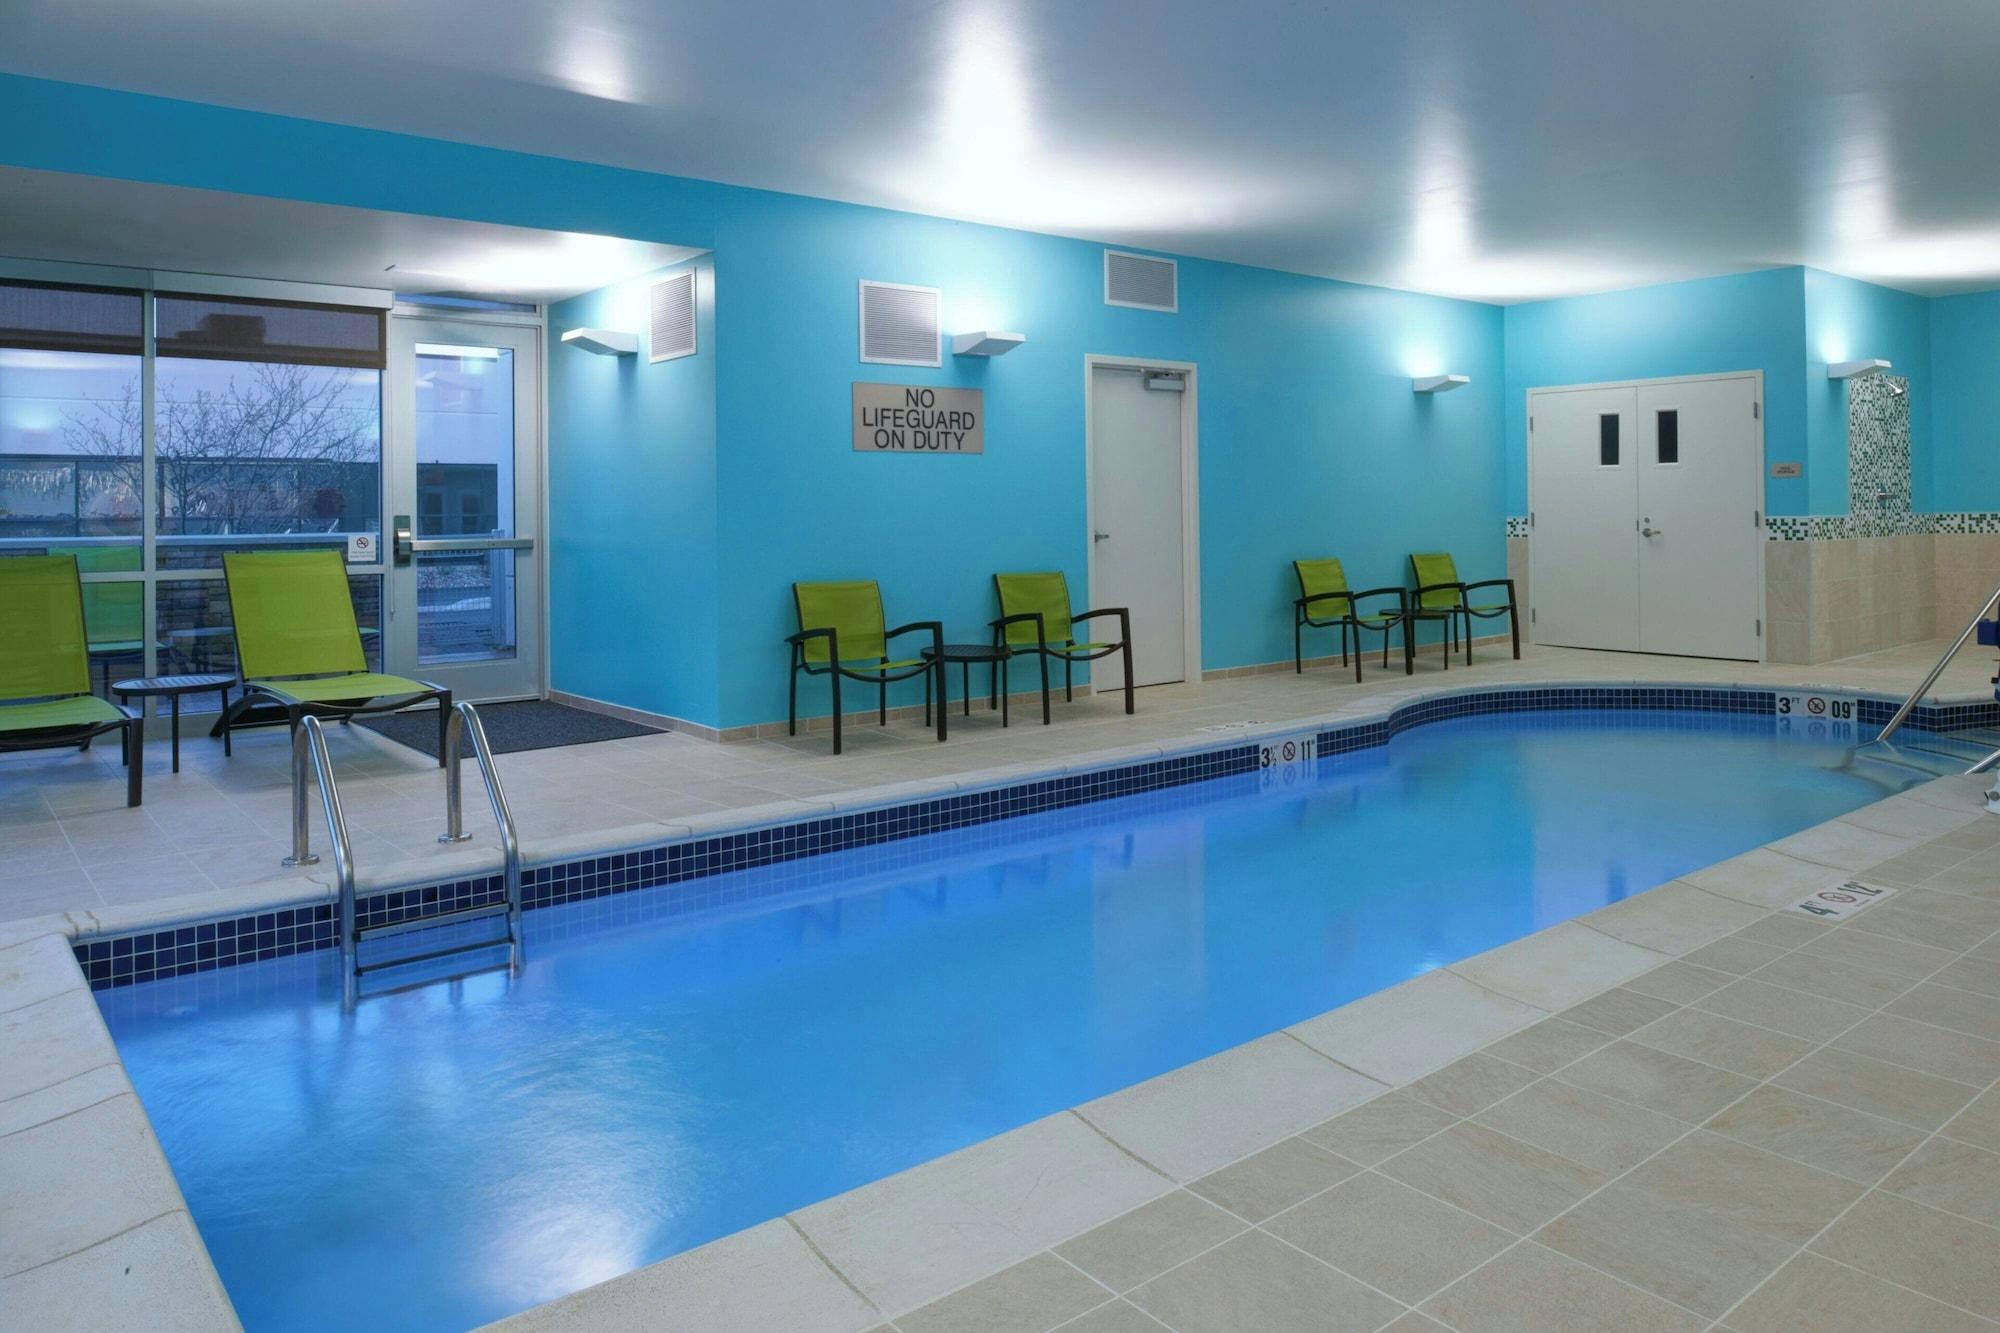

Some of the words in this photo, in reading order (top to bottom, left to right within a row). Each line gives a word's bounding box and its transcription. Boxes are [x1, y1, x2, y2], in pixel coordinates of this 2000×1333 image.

[905, 388, 935, 408] NO
[863, 407, 975, 430] LIFEGUARD
[874, 429, 905, 449] ON
[913, 430, 965, 450] DUTY
